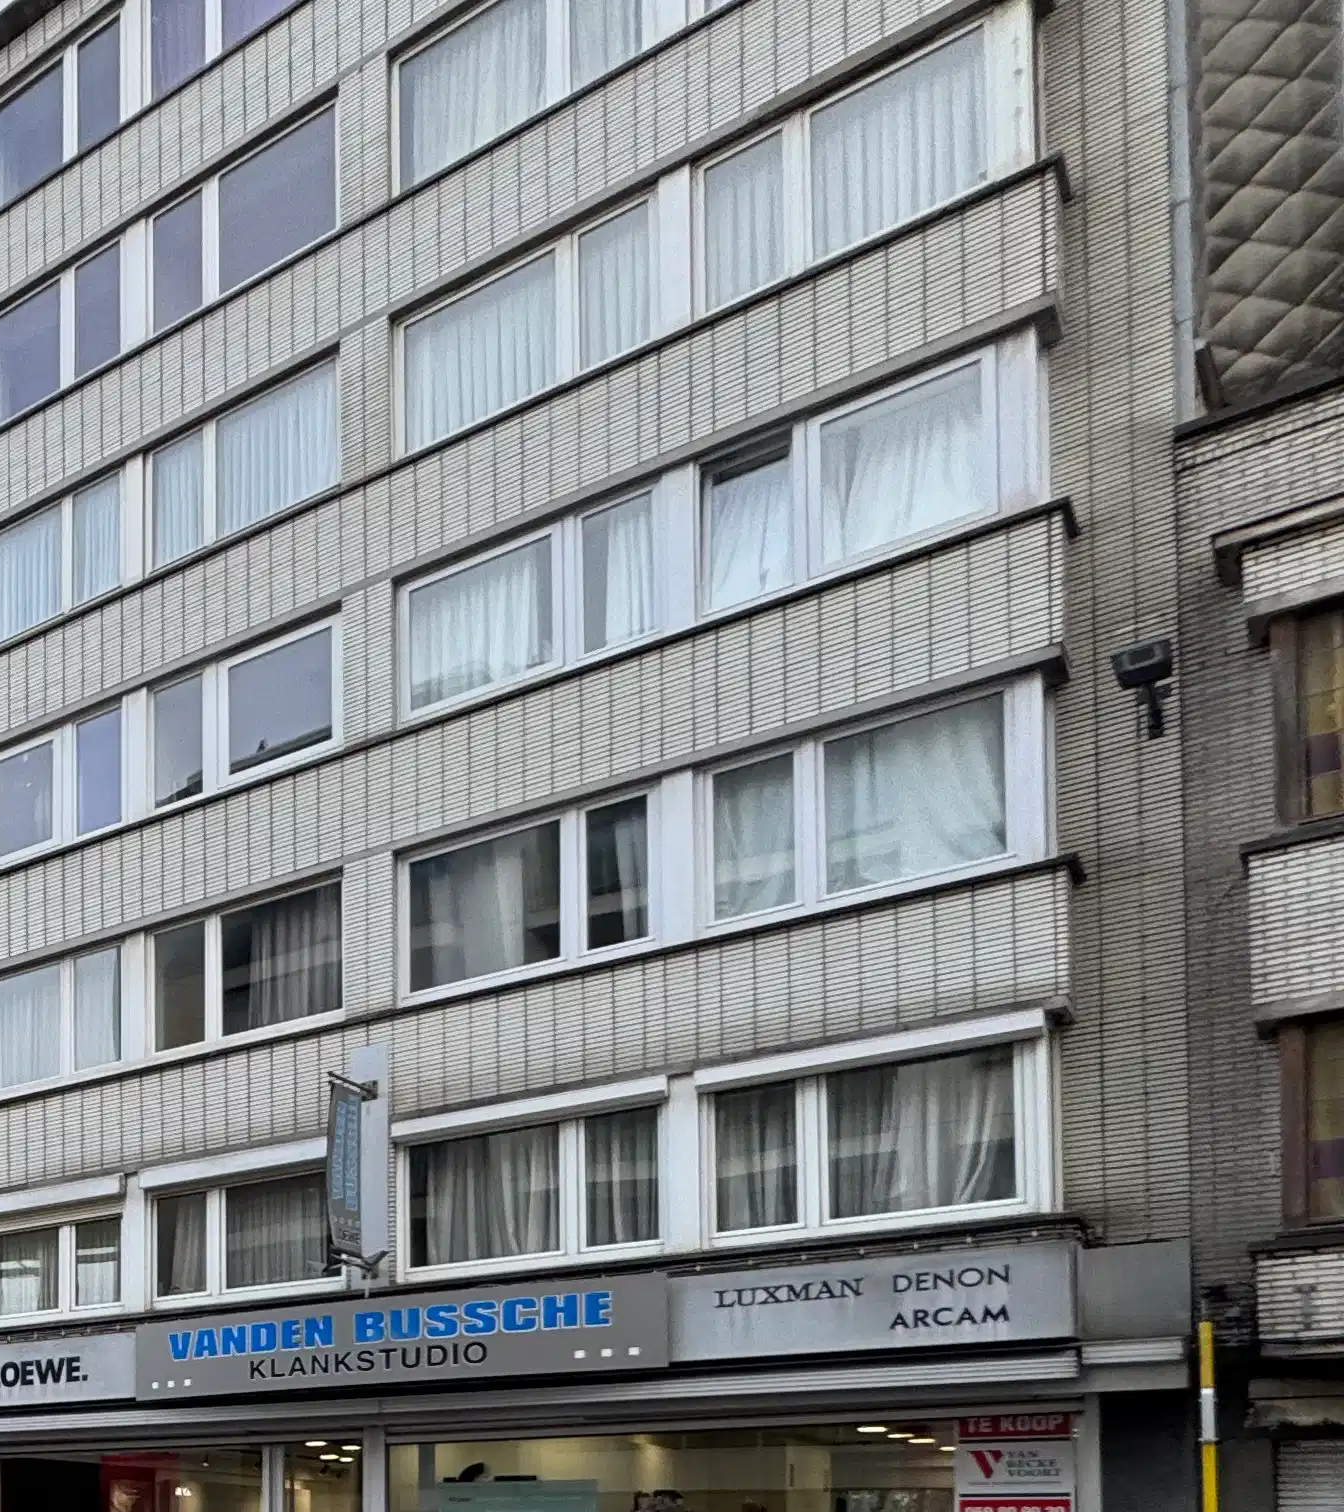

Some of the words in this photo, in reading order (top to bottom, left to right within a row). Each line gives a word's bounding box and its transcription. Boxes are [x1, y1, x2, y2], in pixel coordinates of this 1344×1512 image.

[714, 1277, 866, 1309] LUXMAN
[892, 1264, 1011, 1294] DENON
[168, 1314, 335, 1362] VANDEN
[353, 1290, 614, 1345] BUSSCHE
[889, 1303, 1011, 1331] ARCAM
[248, 1341, 489, 1381] KLANKSTUDIO
[967, 1417, 993, 1433] TE
[999, 1414, 1064, 1433] KOOP
